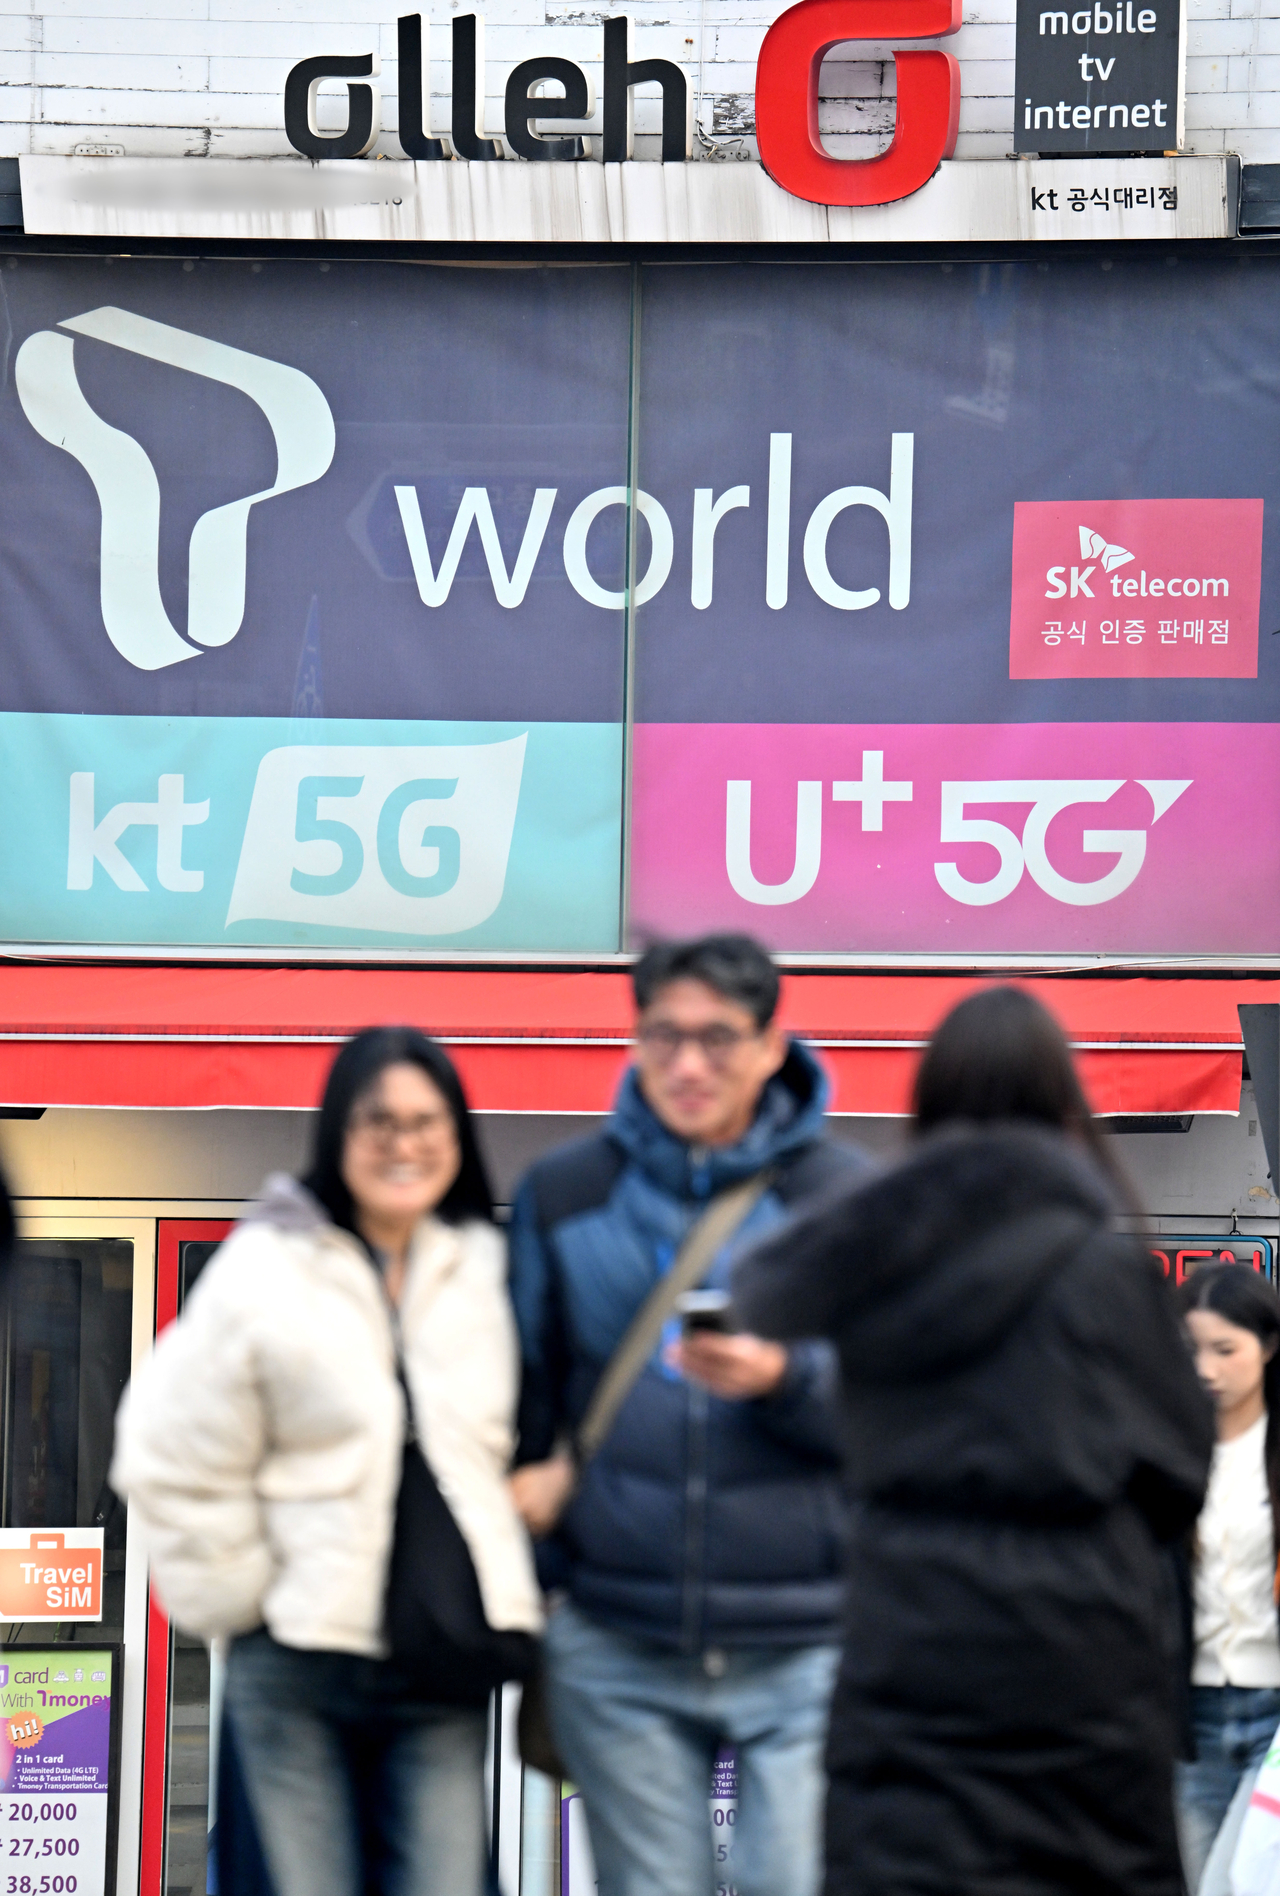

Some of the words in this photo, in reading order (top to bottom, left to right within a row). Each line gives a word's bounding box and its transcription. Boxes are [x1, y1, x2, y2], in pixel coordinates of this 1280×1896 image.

[1039, 1, 1157, 35] mobile
[1078, 53, 1116, 81] tv
[284, 13, 693, 162] olleh
[1024, 98, 1168, 129] internet
[1031, 187, 1059, 211] kt
[1067, 186, 1178, 212] 공식대리점
[394, 432, 914, 611] world
[1044, 566, 1097, 599] SK
[1110, 570, 1229, 598] telecom
[1041, 619, 1087, 646] 공식
[1099, 619, 1147, 645] 인증
[1157, 619, 1230, 645] 판매점
[66, 771, 211, 893] kt
[289, 774, 461, 898] 5G
[933, 779, 1194, 906] 5G
[20, 1563, 92, 1584] Travel
[46, 1586, 92, 1608] SiM
[14, 1667, 49, 1684] card
[1, 1692, 34, 1708] With
[36, 1690, 111, 1711] Tmoney
[10, 1718, 40, 1742] hi!
[15, 1755, 22, 1764] 2
[23, 1755, 33, 1764] in
[35, 1755, 40, 1764] 1
[43, 1754, 64, 1764] card
[72, 1767, 84, 1775] (4G
[84, 1767, 99, 1775] LTE)
[44, 1782, 93, 1790] Transportation
[8, 1803, 77, 1824] 20,000
[8, 1838, 80, 1859] 27,500
[6, 1875, 78, 1896] 38,500
